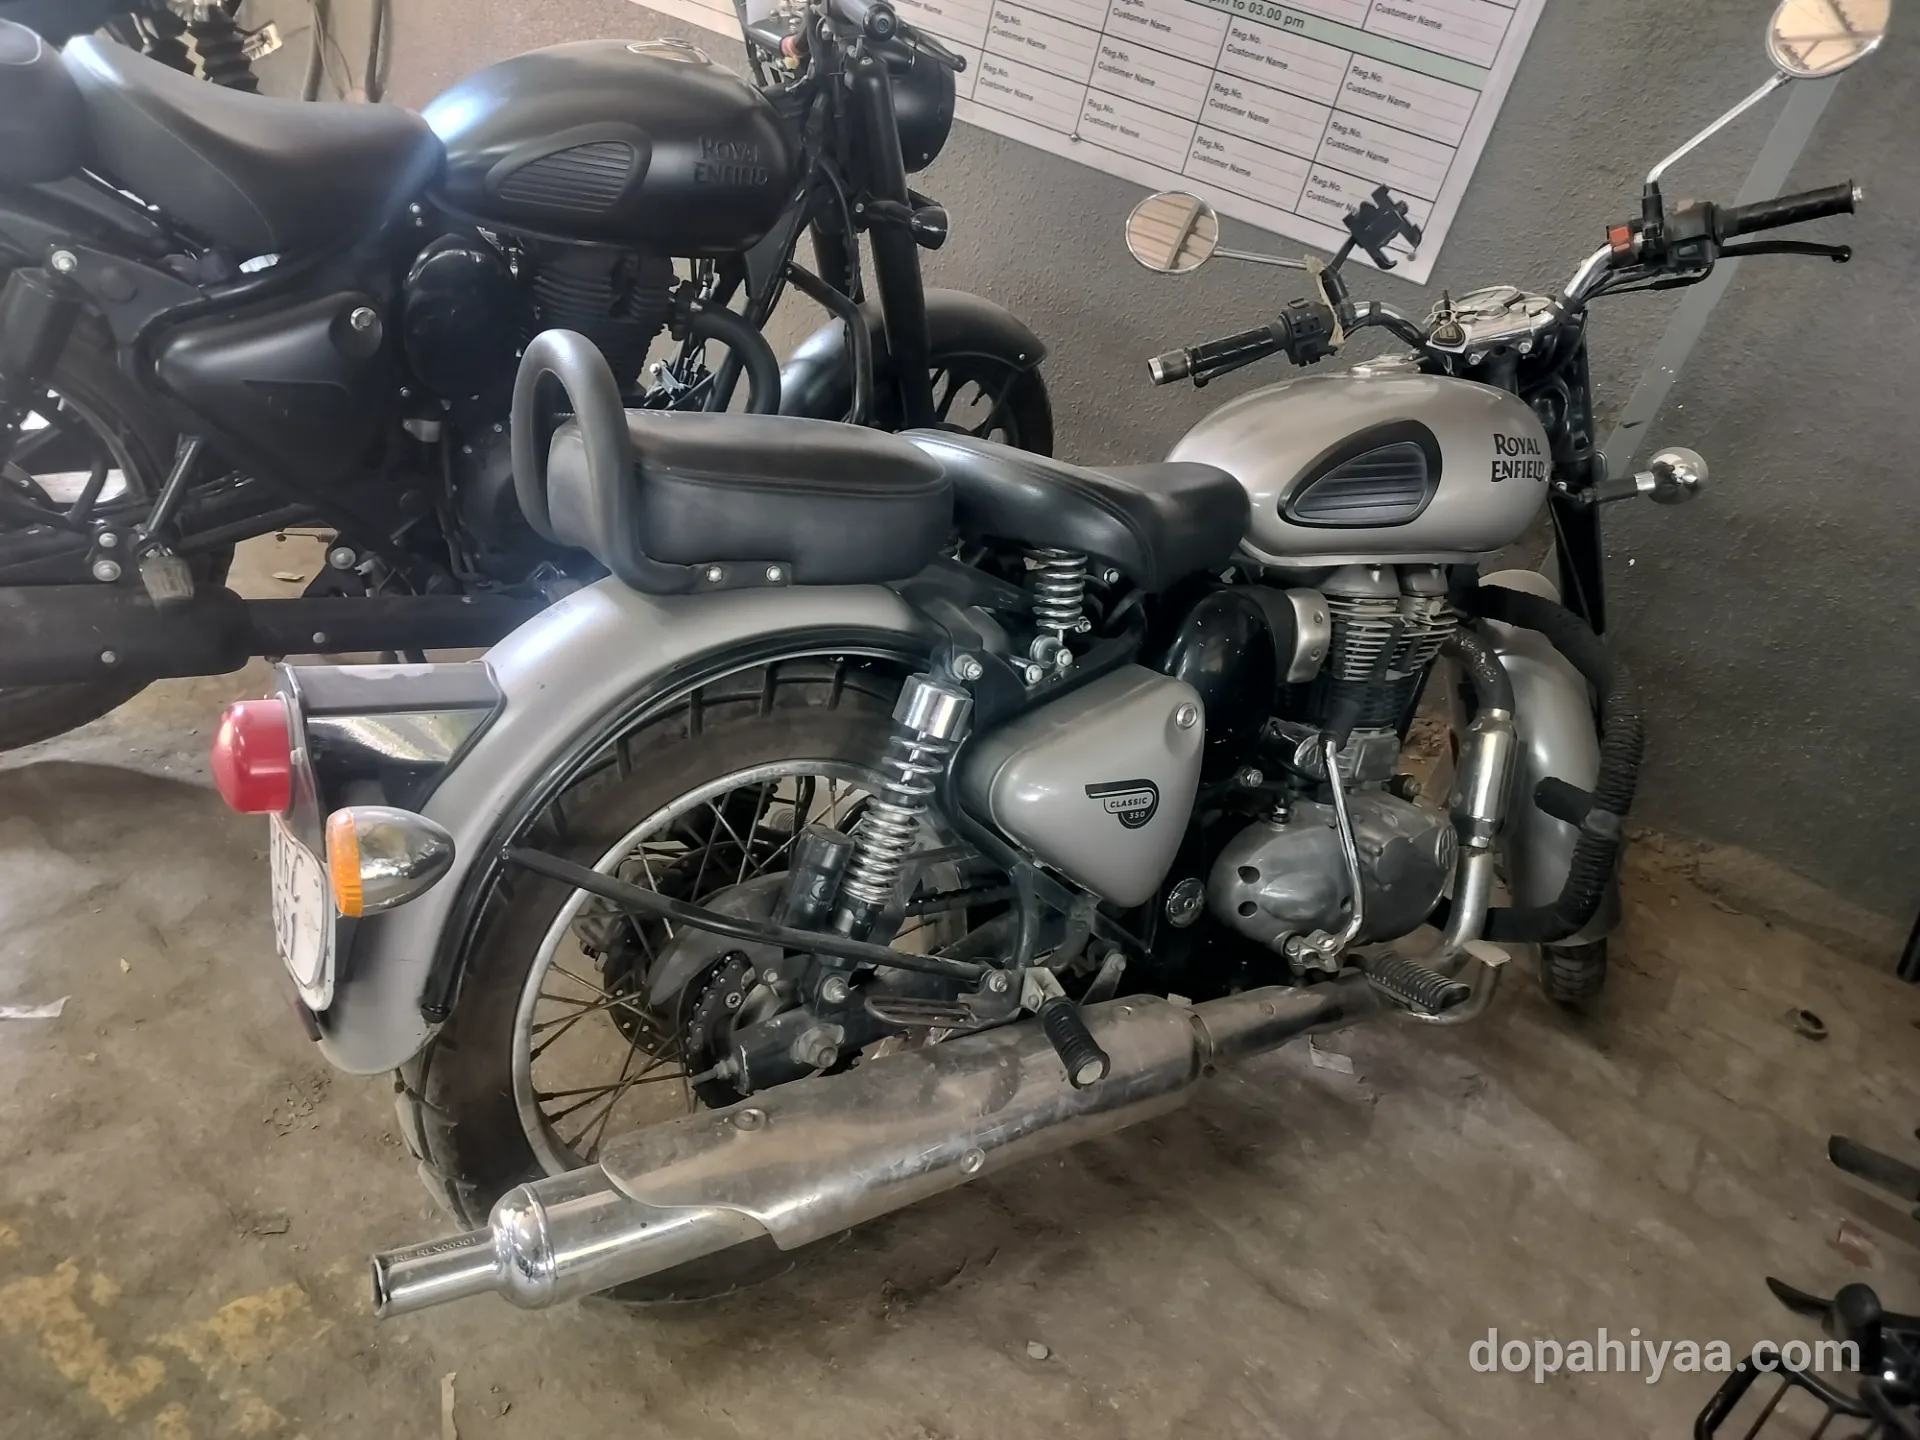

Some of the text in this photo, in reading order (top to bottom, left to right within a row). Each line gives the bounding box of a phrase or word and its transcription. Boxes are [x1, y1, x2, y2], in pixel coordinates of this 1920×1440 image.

[1112, 7, 1171, 32] Customer Name
[1248, 2, 1282, 21] 03.00
[1283, 15, 1305, 28] pm
[1375, 3, 1443, 30] Customer Name
[991, 25, 1047, 50] Customer Name
[1226, 43, 1288, 70] Customer Name
[1098, 61, 1155, 87] Customer Name
[979, 77, 1034, 102] Customer Name
[1346, 82, 1411, 110] Customer Name
[1209, 98, 1270, 125] Customer Name
[1084, 113, 1140, 139] Customer Name
[1325, 136, 1390, 165] Customer Name
[1192, 151, 1252, 177] Customer Name
[1306, 190, 1345, 209] Customer
[1493, 434, 1541, 457] ROYAL
[1491, 461, 1545, 483] ENFIELD
[1110, 797, 1148, 808] CLASSIC
[1129, 811, 1146, 819] 350
